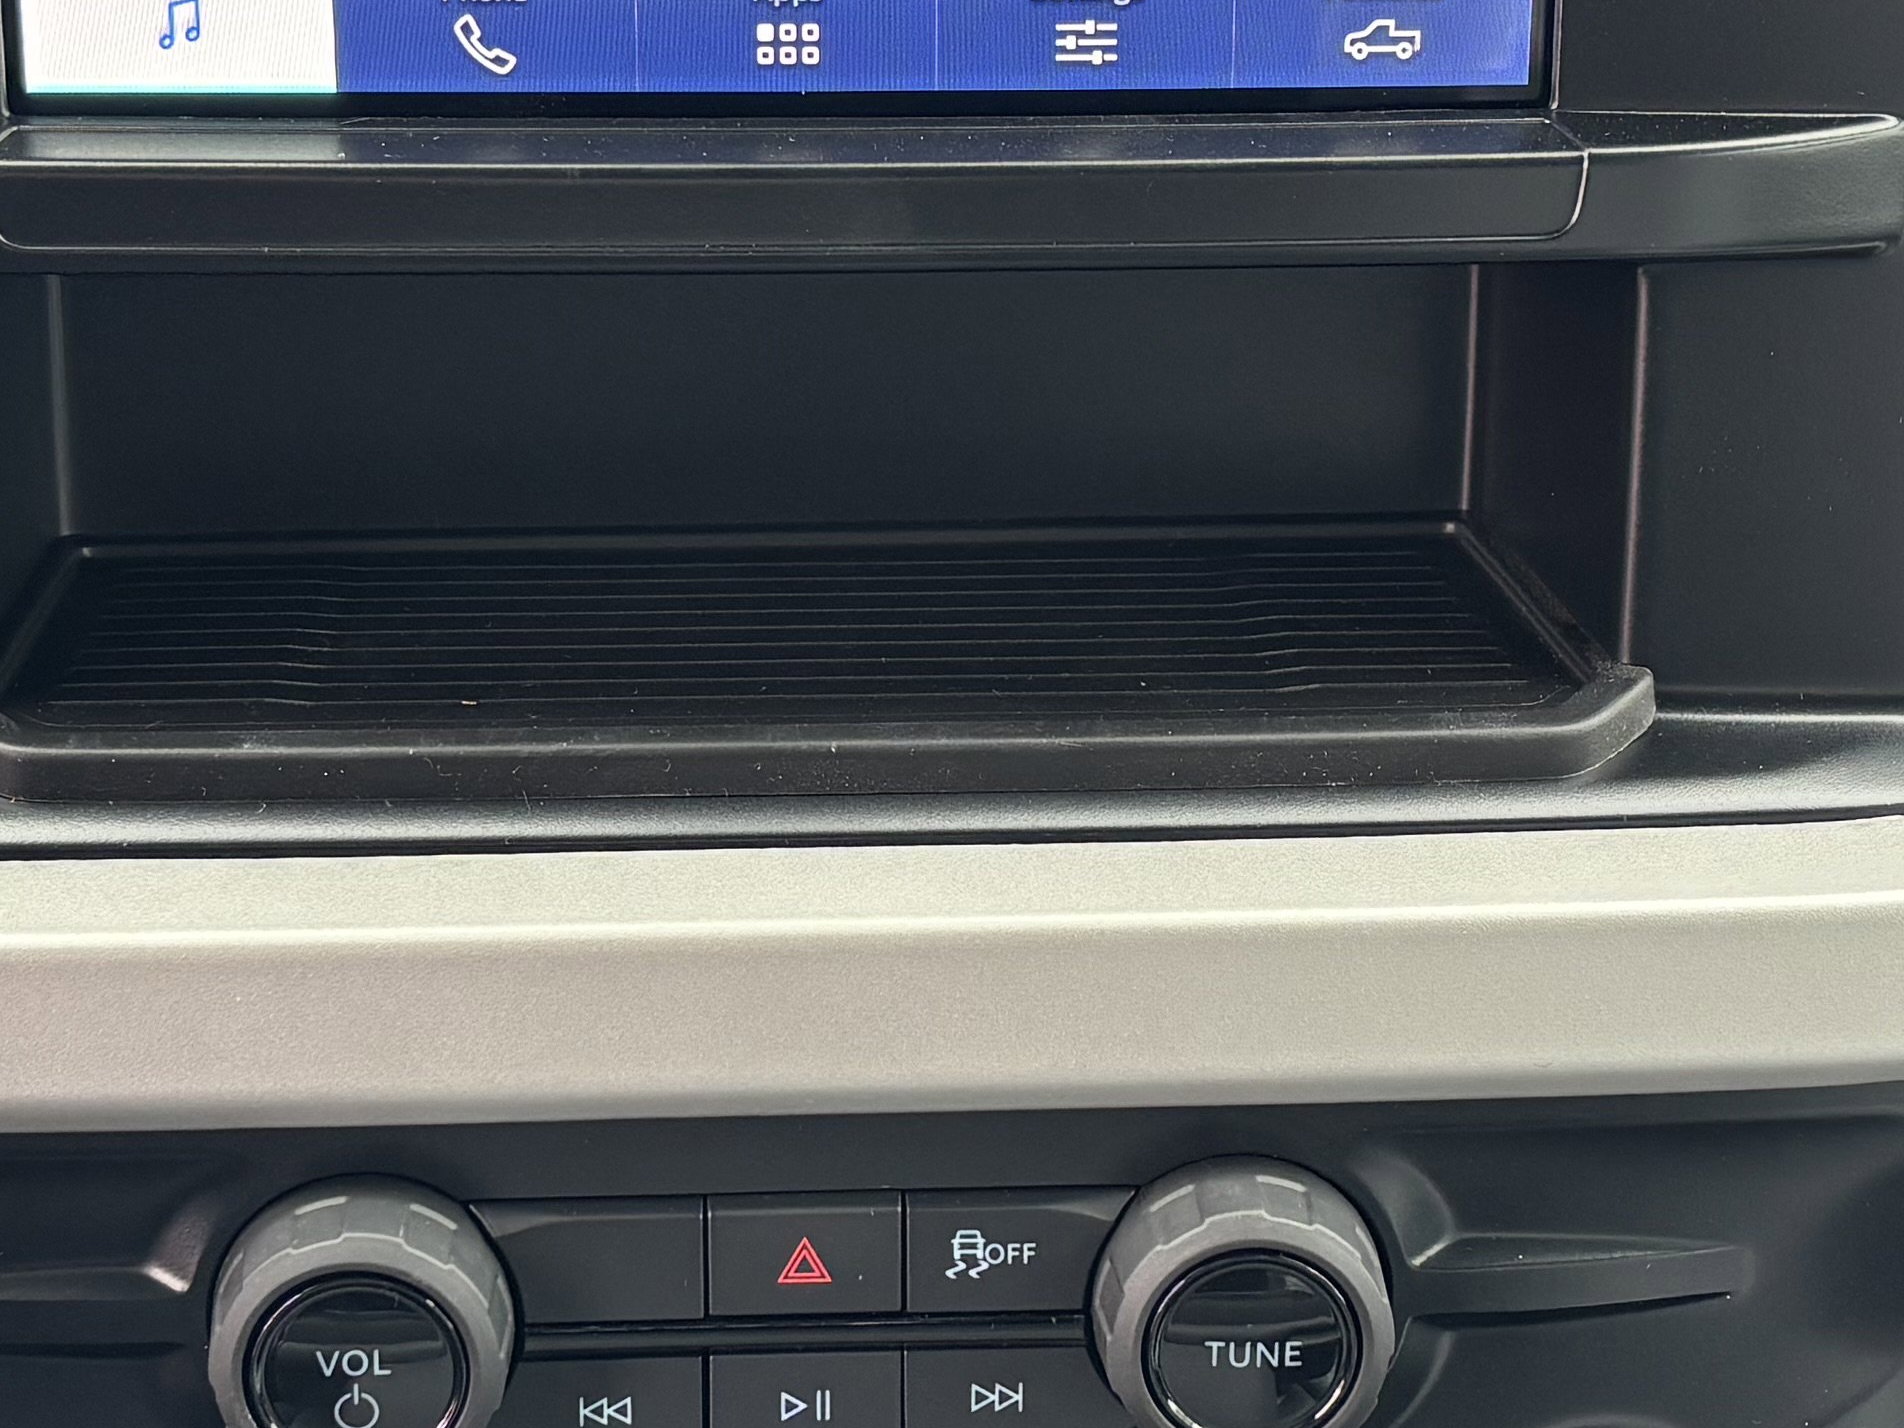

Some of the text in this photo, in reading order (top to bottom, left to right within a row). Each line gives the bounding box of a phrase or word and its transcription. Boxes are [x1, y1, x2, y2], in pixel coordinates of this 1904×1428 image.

[984, 1242, 1037, 1265] OFF
[316, 1349, 392, 1377] VOL
[1205, 1341, 1303, 1368] TUNE
